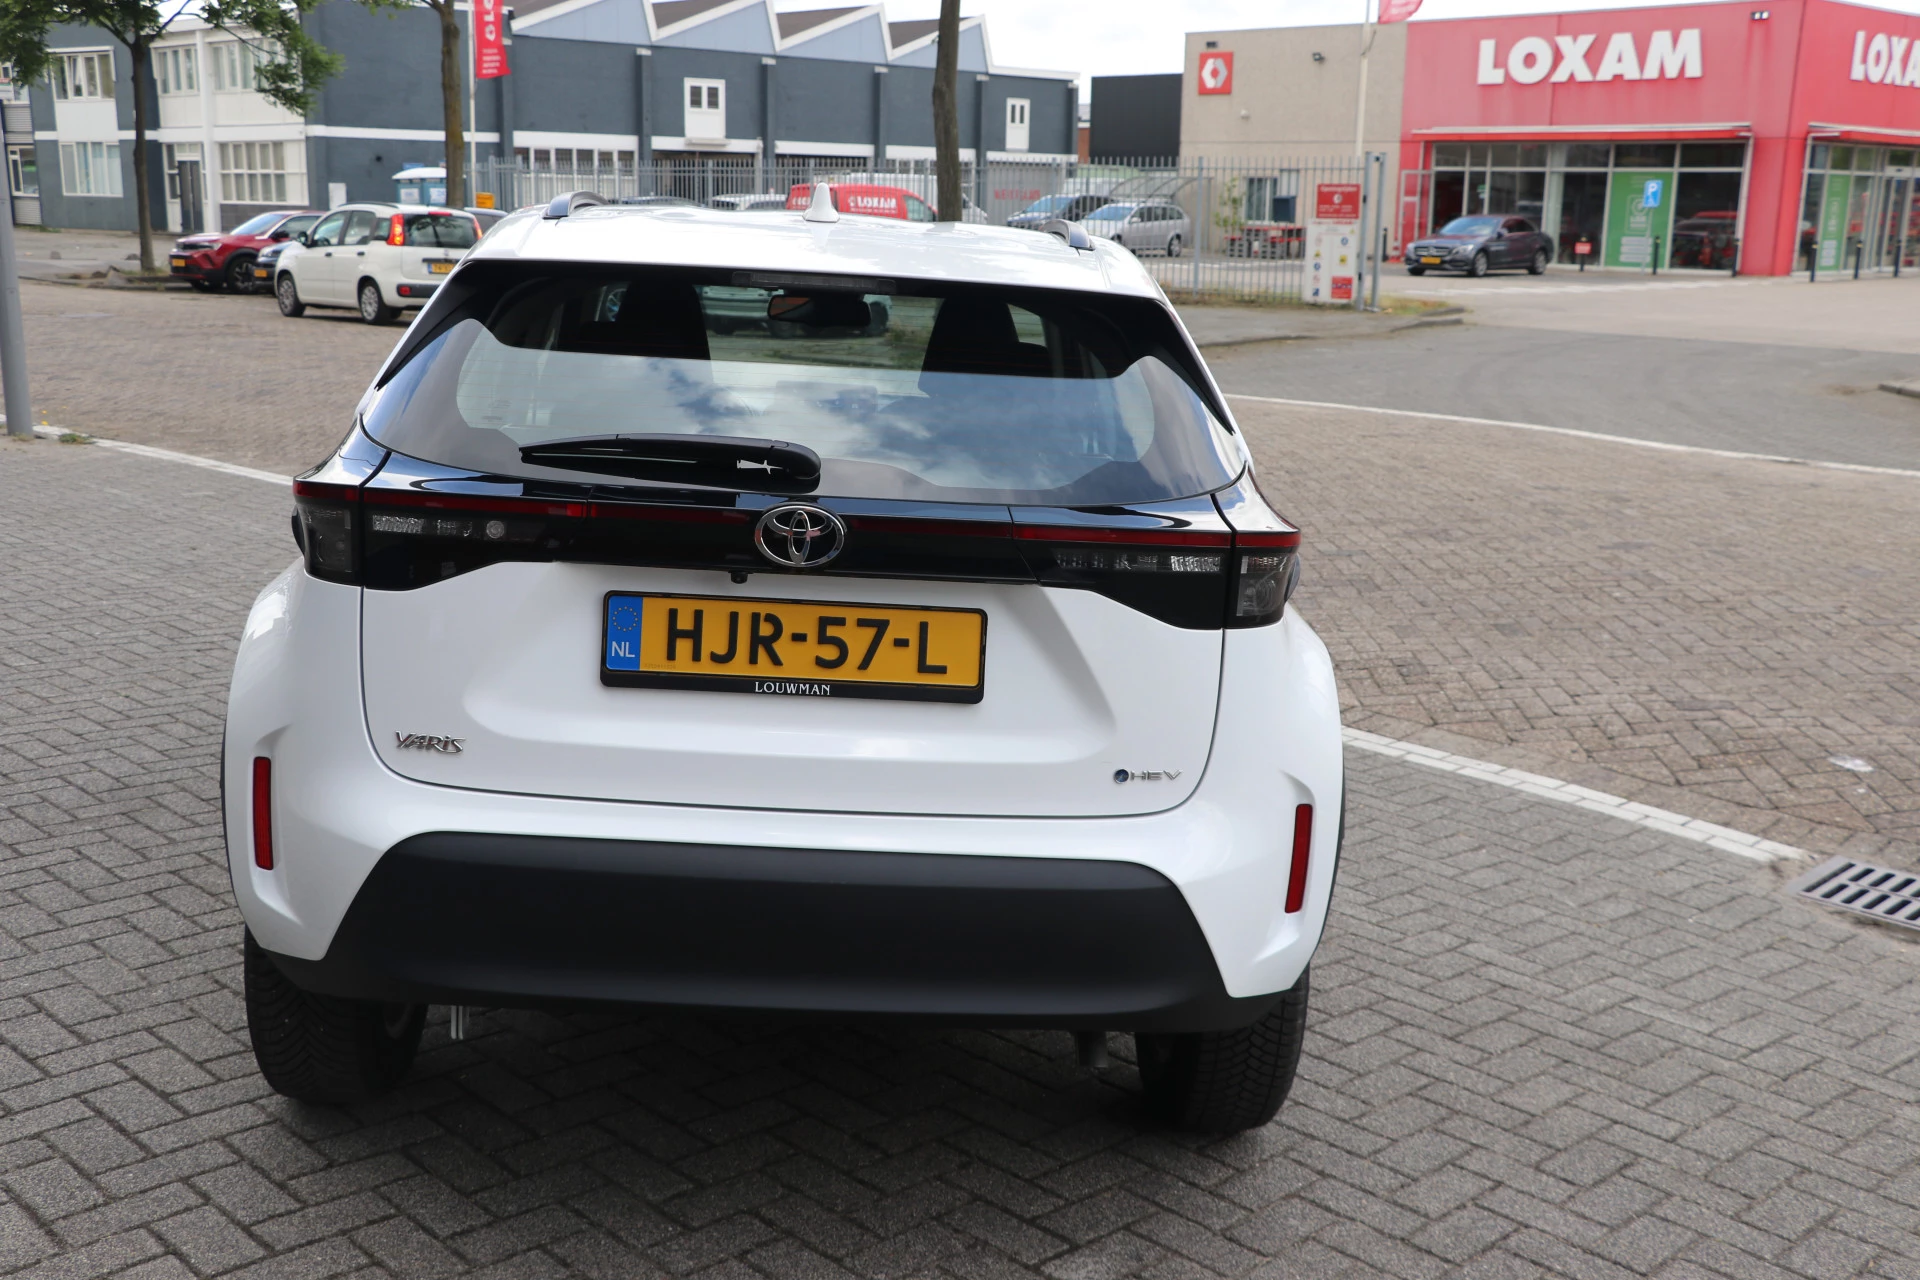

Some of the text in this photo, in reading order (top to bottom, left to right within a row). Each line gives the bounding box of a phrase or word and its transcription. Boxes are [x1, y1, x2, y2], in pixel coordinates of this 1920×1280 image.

[1477, 28, 1703, 85] LOXAM
[611, 641, 636, 658] NL
[666, 607, 948, 675] HJR-57-L
[754, 681, 832, 696] LOUWMAN
[1130, 770, 1183, 781] HEV
